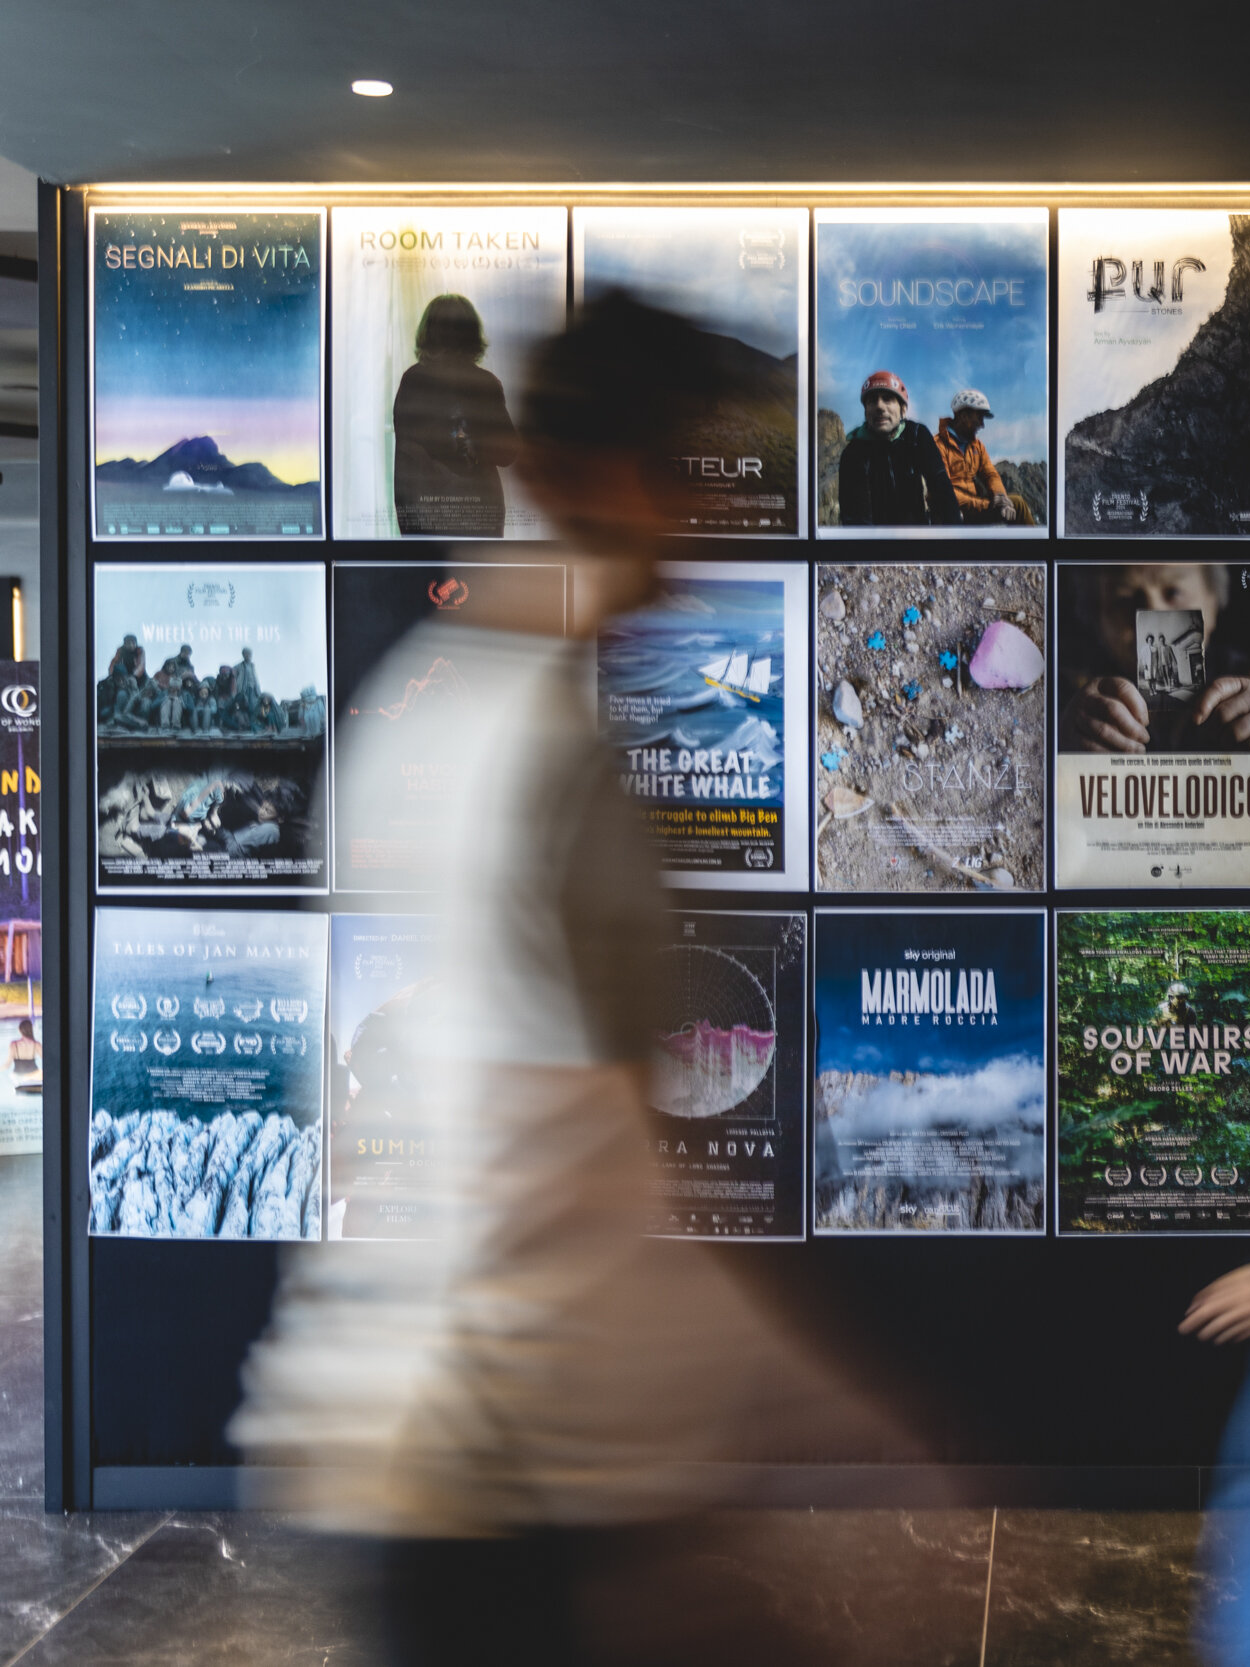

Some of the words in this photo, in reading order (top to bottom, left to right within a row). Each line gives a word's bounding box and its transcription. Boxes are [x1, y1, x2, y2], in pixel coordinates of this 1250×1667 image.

[360, 231, 444, 250] ROOM
[451, 231, 539, 250] TAKEN
[106, 245, 212, 269] SEGNALI
[222, 245, 244, 269] DI
[253, 245, 310, 268] VITA
[839, 279, 1025, 307] SOUNDSCAPE
[672, 457, 762, 478] TEUR
[142, 623, 195, 643] WHEELS
[200, 624, 222, 642] ON
[228, 624, 250, 642] THE
[257, 624, 280, 643] BUS
[626, 748, 672, 773] THE
[678, 748, 754, 774] GREAT
[903, 759, 1032, 792] STANZE
[692, 776, 772, 799] WHALE
[650, 809, 694, 824] struggle
[696, 810, 707, 822] to
[709, 808, 738, 823] climb
[739, 808, 756, 826] Big
[757, 808, 778, 824] Ben
[113, 943, 165, 956] TALES
[174, 943, 196, 957] OF
[203, 944, 236, 961] JAN
[246, 945, 310, 959] MAYEN
[904, 947, 920, 961] sky
[921, 947, 956, 962] original
[861, 967, 998, 1014] MARMOLADA
[862, 1014, 920, 1025] MADRE
[932, 1014, 998, 1025] ROCCIA
[1110, 1050, 1151, 1075] OF
[1159, 1050, 1232, 1075] WAR
[707, 1141, 775, 1157] NOVA
